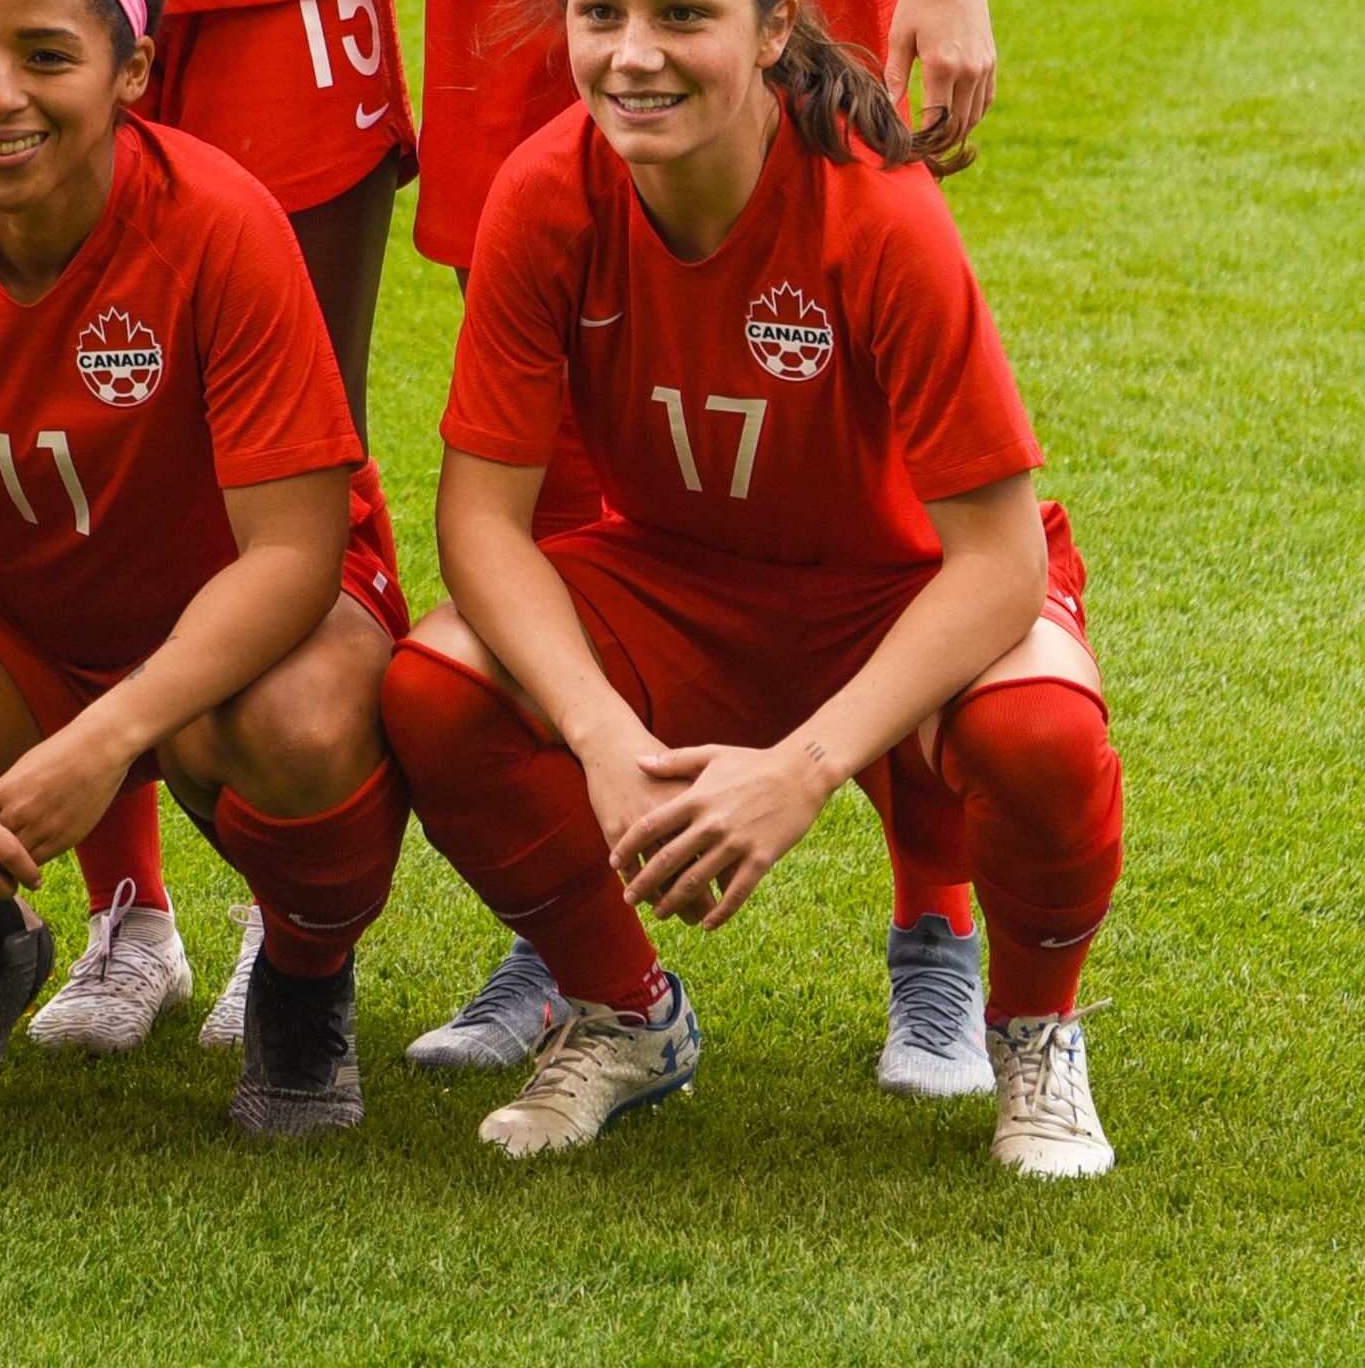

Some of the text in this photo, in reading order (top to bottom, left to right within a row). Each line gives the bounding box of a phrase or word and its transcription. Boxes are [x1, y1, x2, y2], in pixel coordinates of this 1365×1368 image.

[747, 325, 830, 345] CANADA
[79, 352, 159, 368] CANADA
[651, 385, 768, 500] 17
